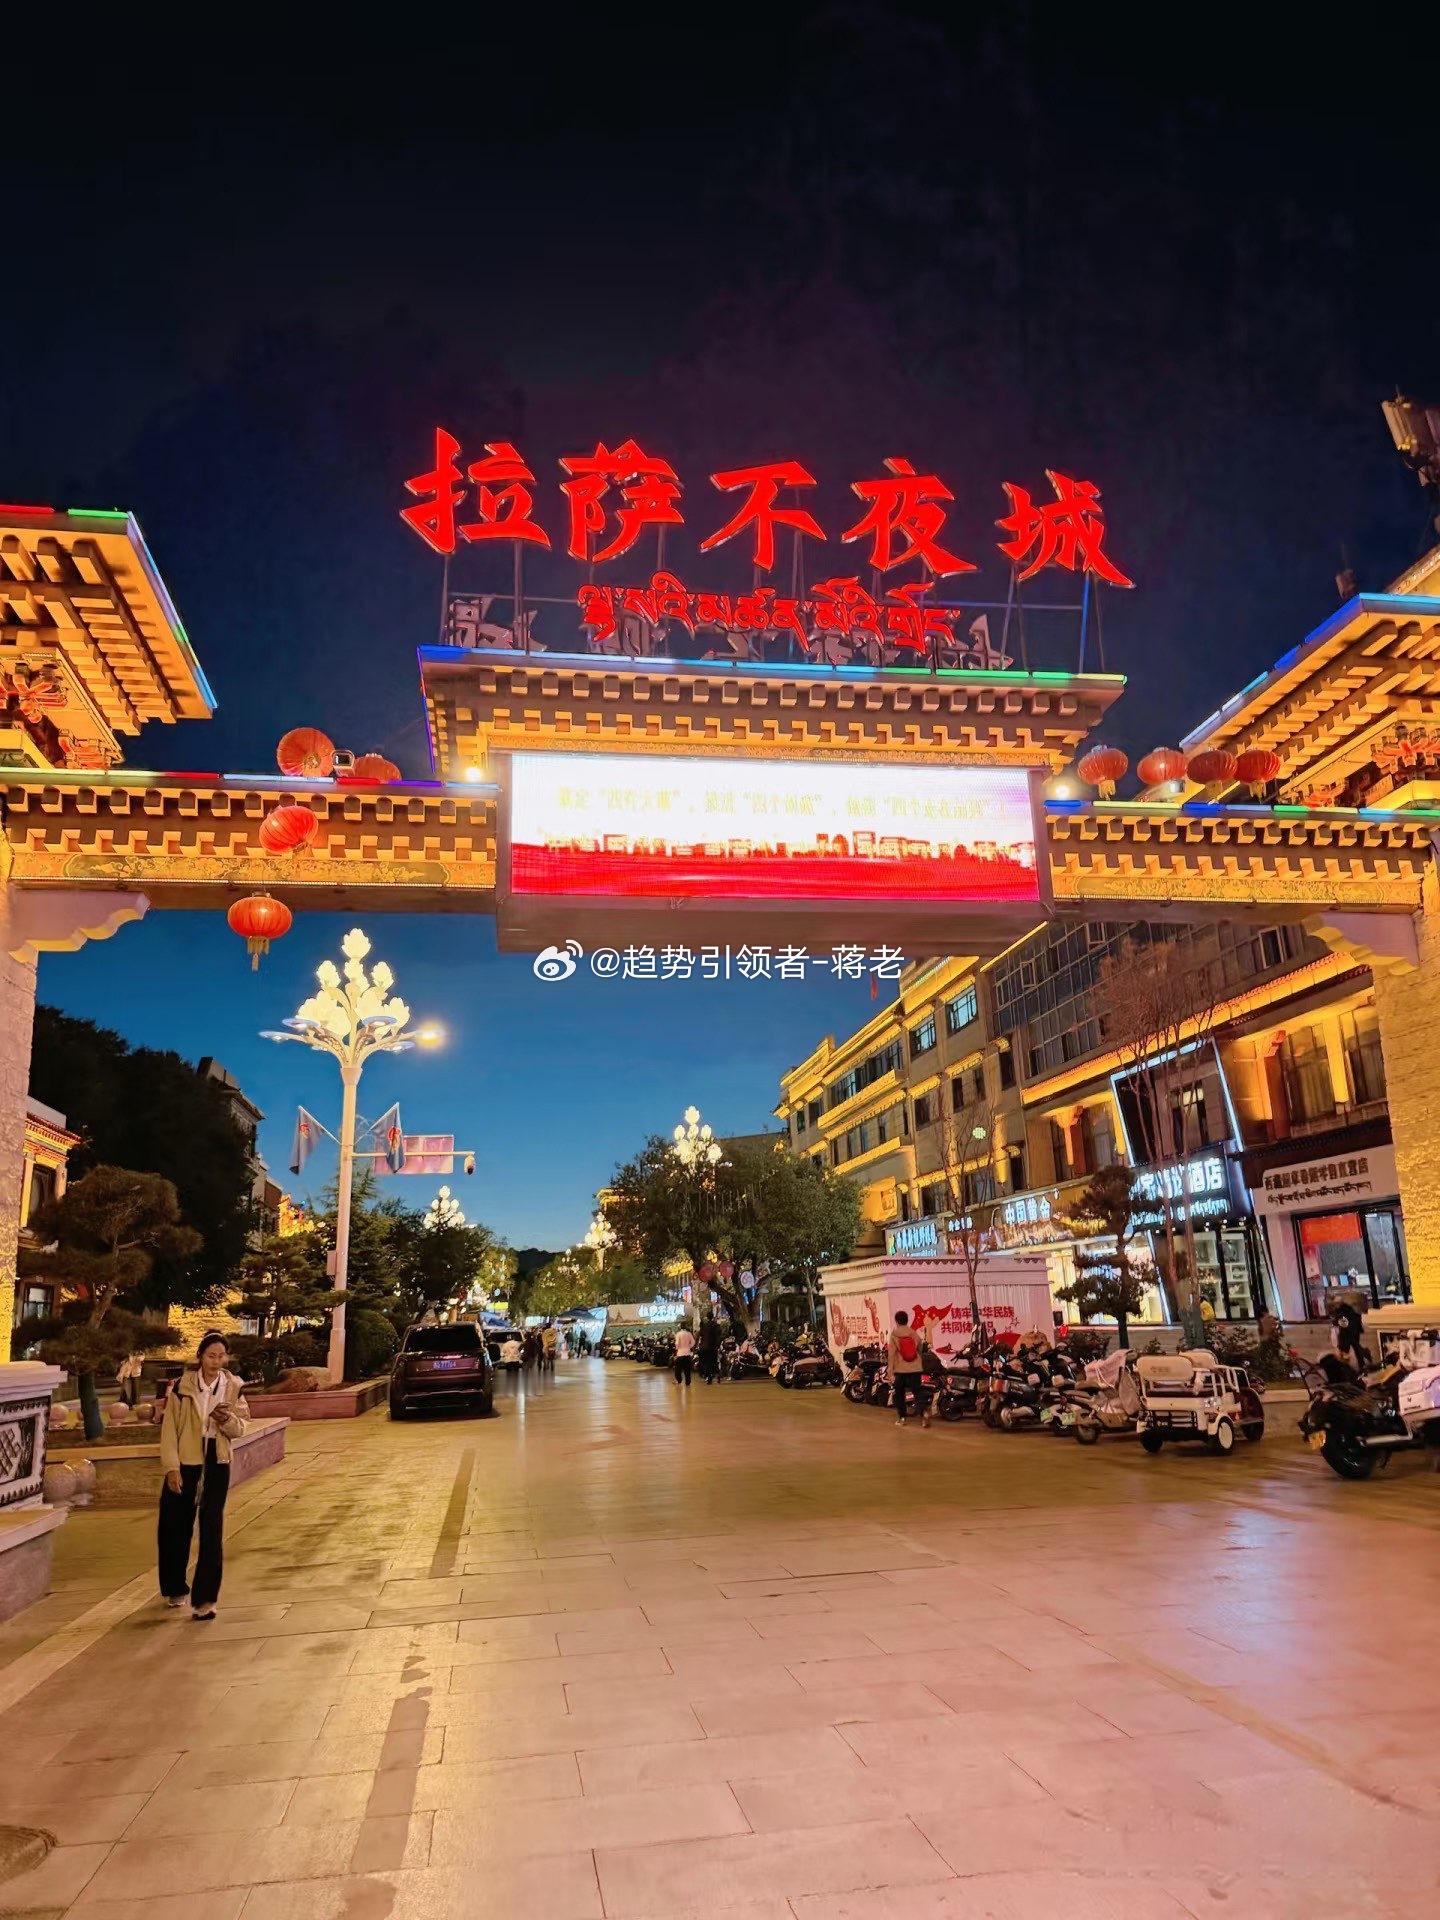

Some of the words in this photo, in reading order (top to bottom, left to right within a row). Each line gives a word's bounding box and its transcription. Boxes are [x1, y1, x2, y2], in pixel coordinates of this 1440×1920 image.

[400, 426, 1136, 590] 拉萨不夜城
[951, 1306, 1015, 1319] 铸牢华民族
[941, 1320, 994, 1334] 共同体识
